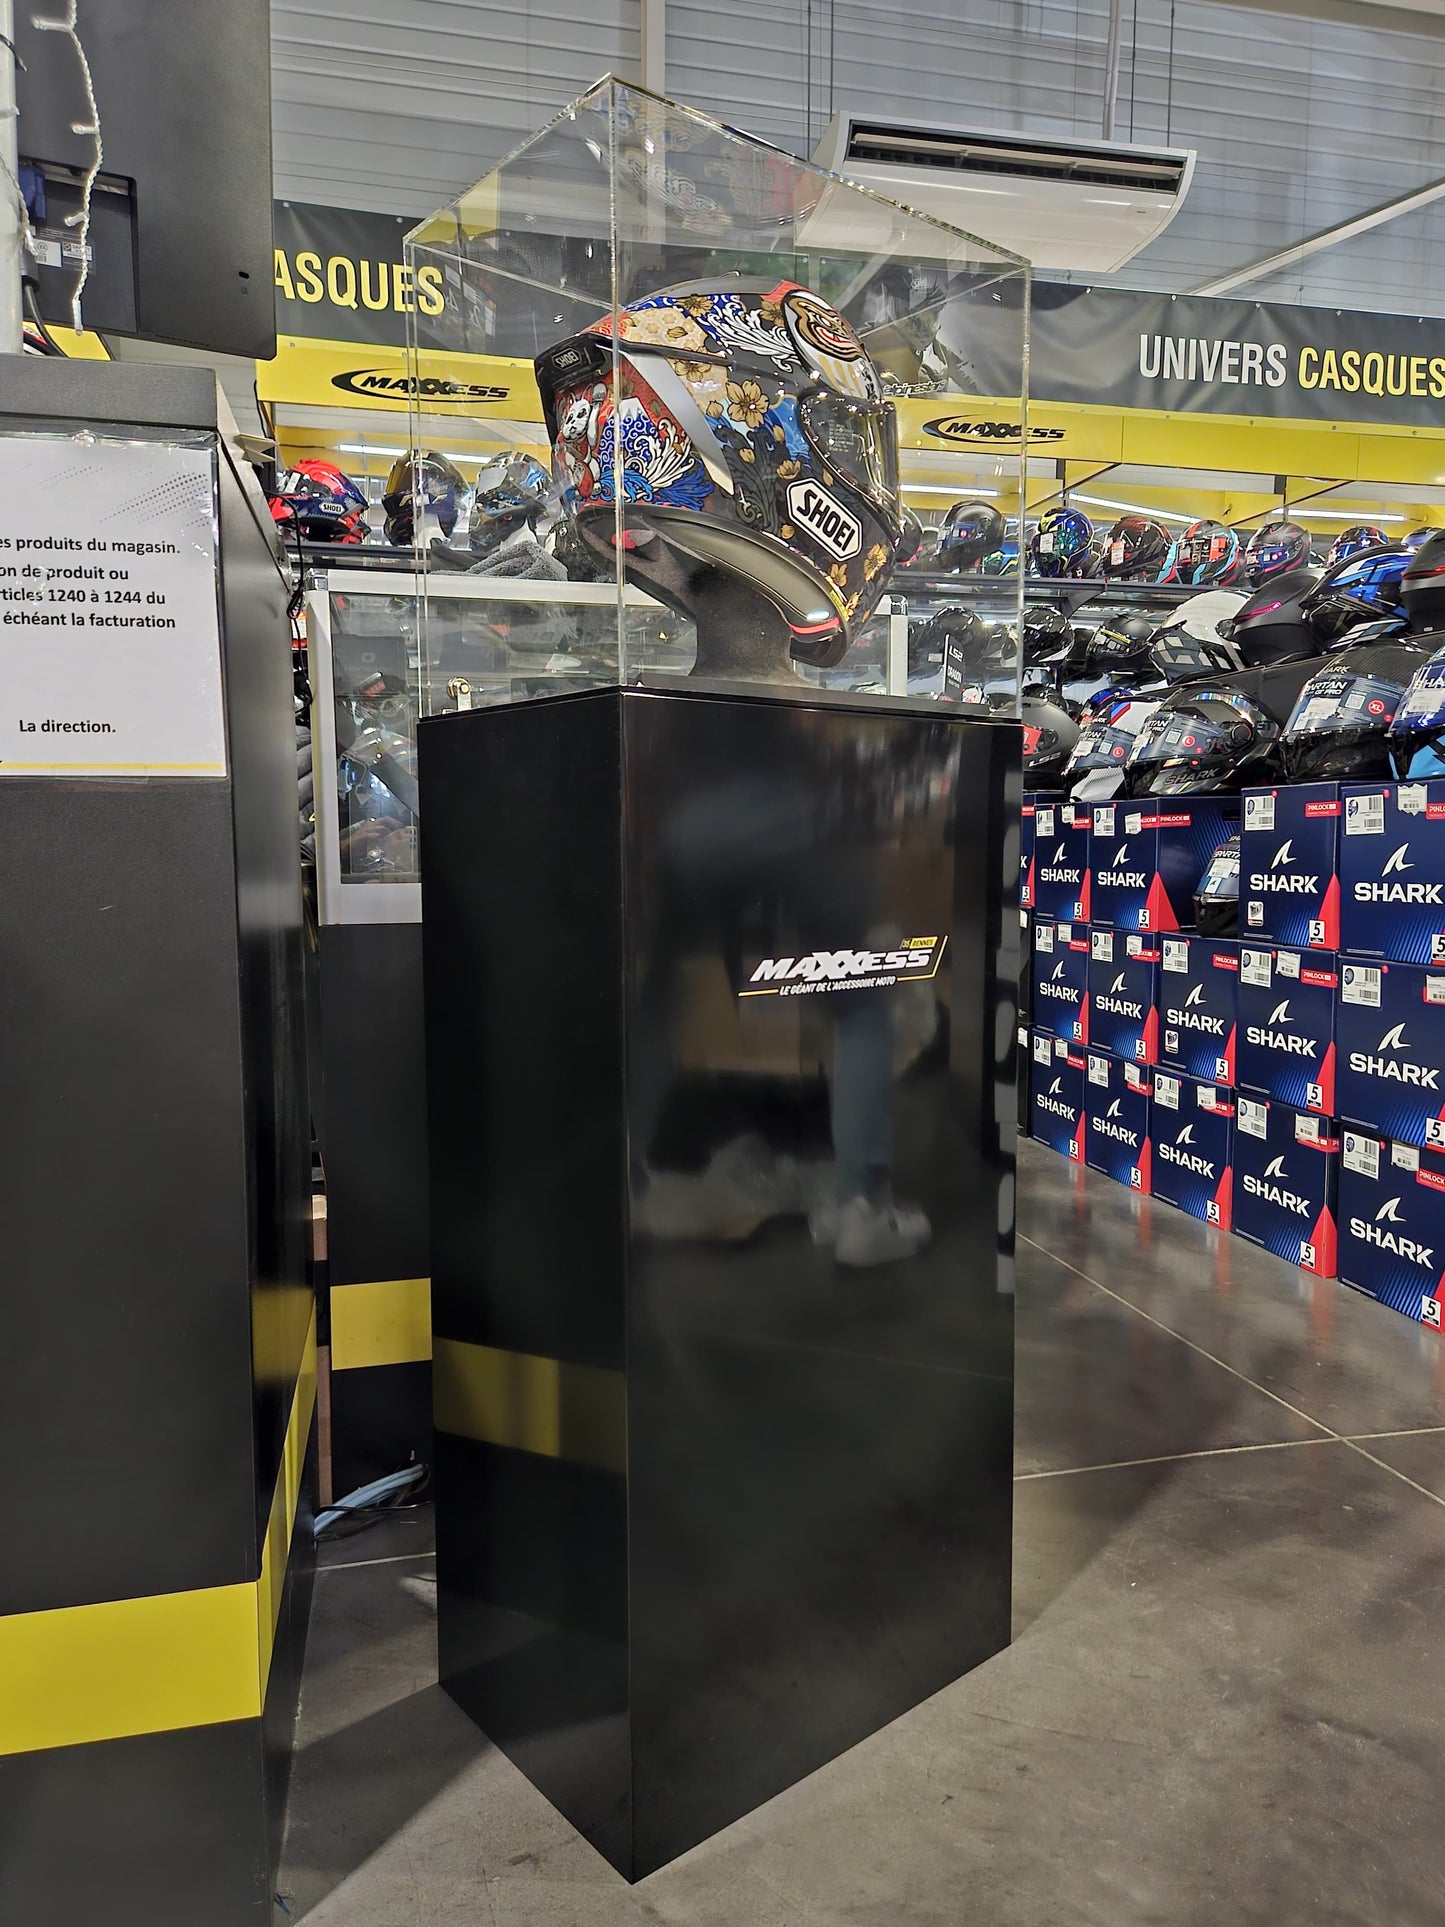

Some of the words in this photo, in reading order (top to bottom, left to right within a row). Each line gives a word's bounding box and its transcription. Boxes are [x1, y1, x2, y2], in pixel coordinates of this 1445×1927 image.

[555, 351, 579, 368] SHOEI
[1139, 333, 1288, 387] UNIVERS
[1297, 346, 1445, 399] CASQUES
[360, 376, 510, 398] MAXXESS
[946, 421, 1066, 441] MAXXESS
[323, 503, 342, 512] SHOEI
[797, 489, 856, 551] SHOEI
[16, 536, 82, 552] produits
[88, 538, 107, 551] du
[112, 540, 180, 556] magasin.
[22, 564, 41, 578] de
[46, 565, 104, 580] produit
[109, 569, 129, 580] ou
[0, 587, 43, 601] ticles
[48, 589, 86, 602] 1240
[90, 589, 100, 603] à
[104, 591, 142, 604] 1244
[146, 591, 166, 604] du
[4, 611, 66, 626] échéant
[72, 613, 85, 626] la
[90, 613, 176, 628] facturation
[1370, 703, 1382, 712] XL
[19, 720, 36, 732] La
[41, 719, 116, 733] direction.
[1164, 768, 1220, 785] SHARK
[1040, 868, 1080, 883] SHARK
[1097, 871, 1146, 888] SHARK
[1250, 874, 1320, 894] SHARK
[1354, 882, 1444, 905] SHARK
[1076, 904, 1081, 914] 5
[1141, 911, 1147, 922] 5
[1314, 922, 1320, 936] 5
[1437, 936, 1445, 952] 5
[750, 949, 932, 982] MAXXESS
[780, 986, 789, 996] LE
[790, 982, 816, 995] GÉANT
[816, 982, 827, 992] DE
[827, 978, 875, 992] L'ACCESSOIRE
[876, 976, 896, 987] MOTO
[1040, 982, 1079, 1004] SHARK
[1096, 996, 1142, 1020] SHARK
[1075, 1024, 1080, 1034] 5
[1166, 1009, 1224, 1036] SHARK
[1138, 1042, 1144, 1054] 5
[1246, 1026, 1317, 1058] SHARK
[1219, 1061, 1226, 1073] 5
[1350, 1052, 1440, 1090] SHARK
[1311, 1086, 1318, 1099] 5
[1036, 1094, 1076, 1122] SHARK
[1092, 1116, 1138, 1148] SHARK
[1430, 1123, 1441, 1137] 5
[1071, 1143, 1076, 1154] 5
[1158, 1142, 1215, 1180] SHARK
[1133, 1170, 1139, 1182] 5
[1243, 1175, 1310, 1218] SHARK
[1210, 1205, 1216, 1216] 5
[1350, 1217, 1434, 1270] SHARK
[1304, 1245, 1312, 1260] 5
[1427, 1301, 1436, 1316] 5
